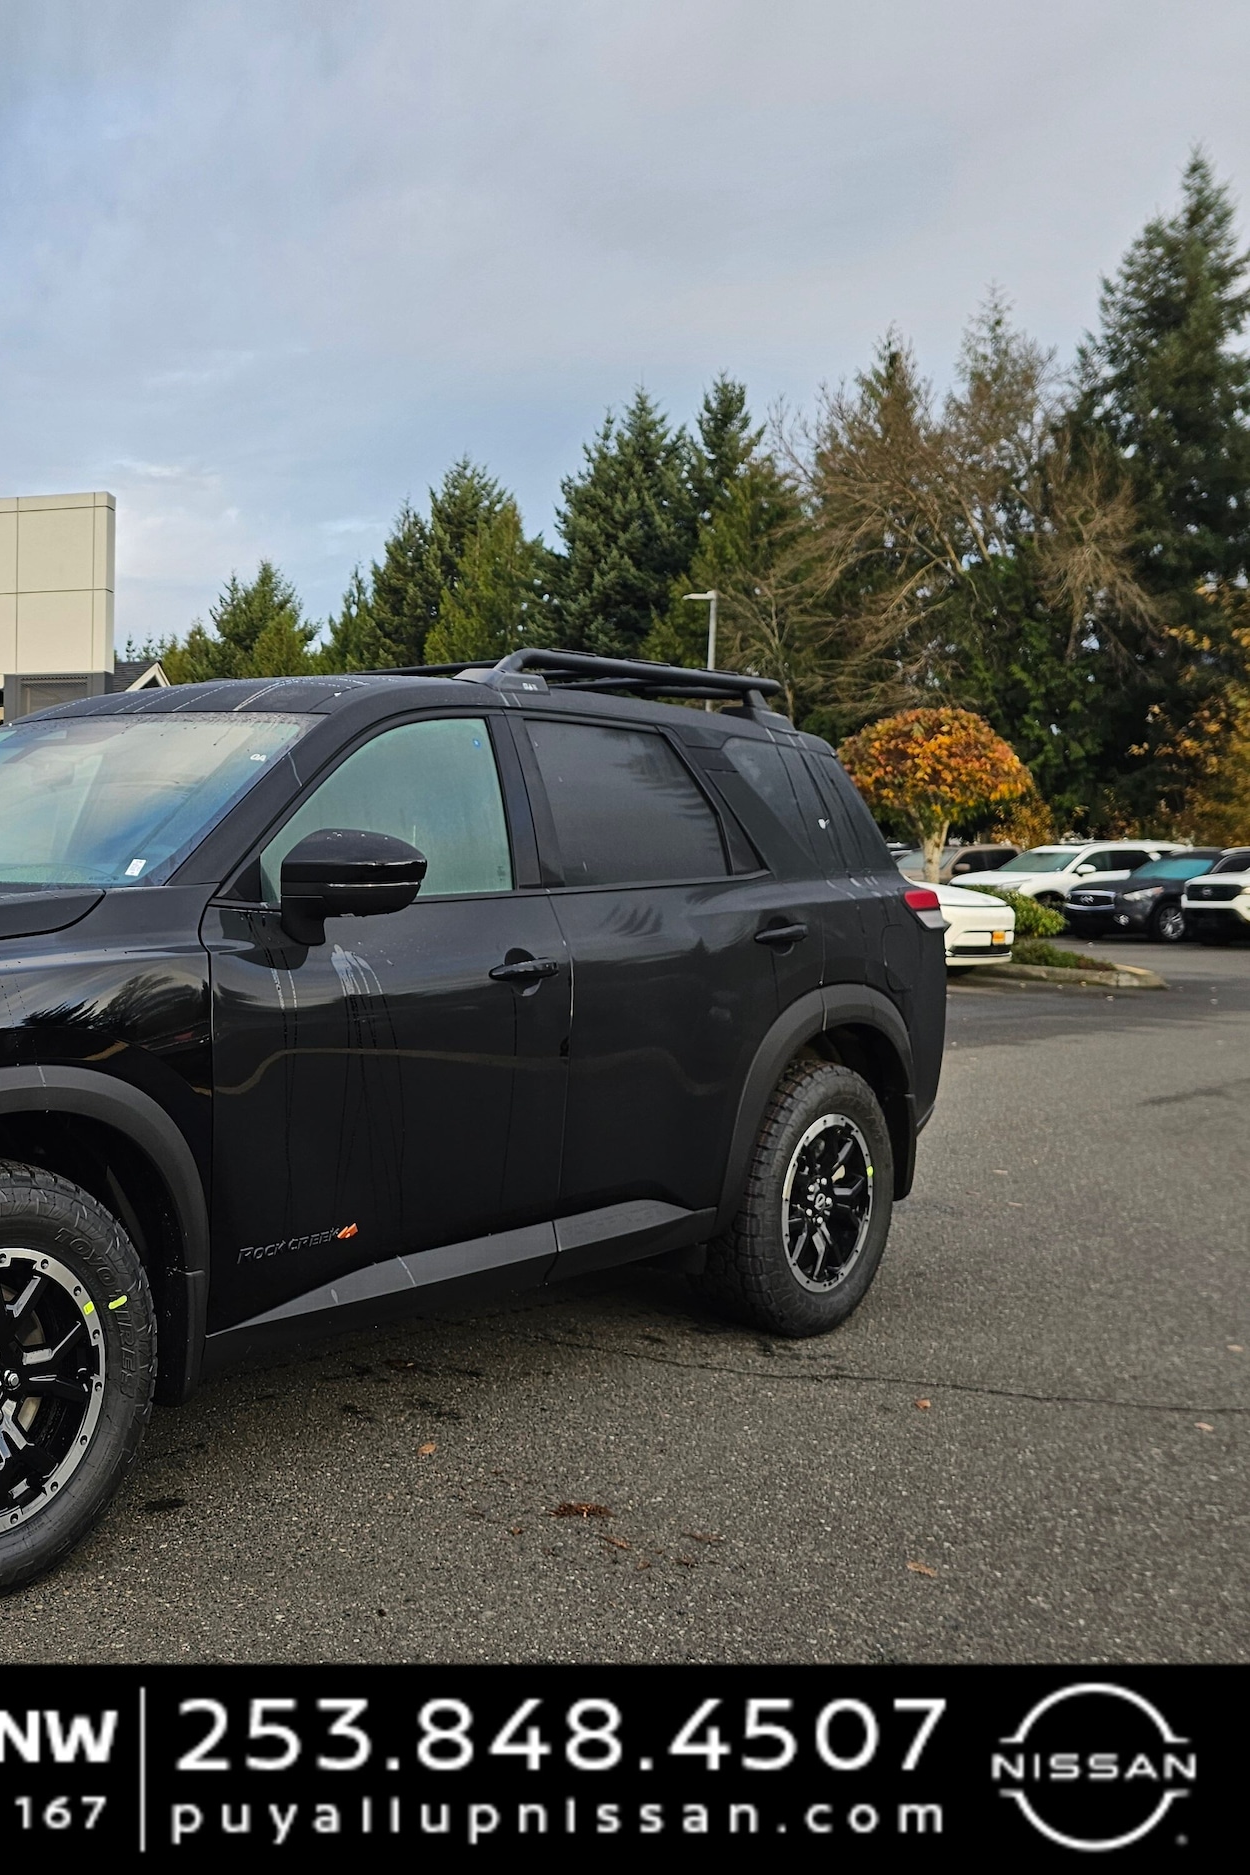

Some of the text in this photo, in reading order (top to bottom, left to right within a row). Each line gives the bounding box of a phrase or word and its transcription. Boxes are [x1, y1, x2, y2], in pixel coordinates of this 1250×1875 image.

[54, 1227, 119, 1287] TOYO
[237, 1228, 340, 1264] ROCK CREEK
